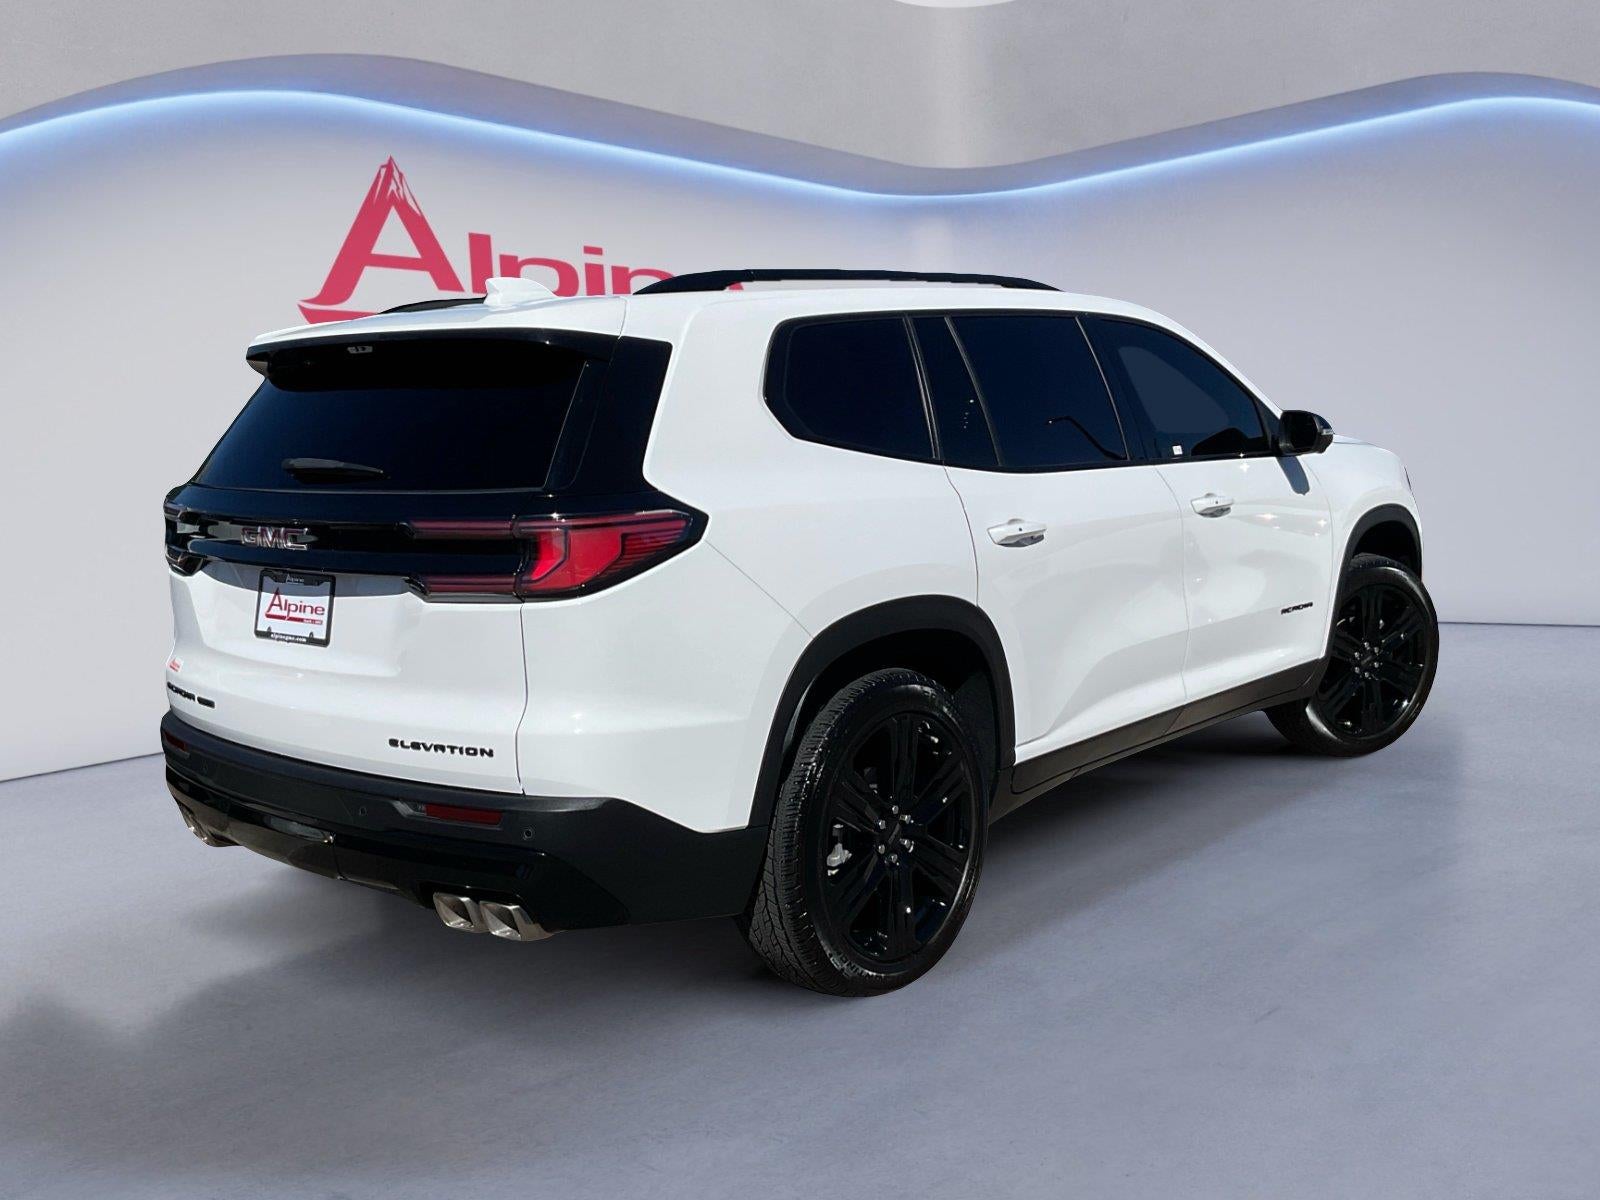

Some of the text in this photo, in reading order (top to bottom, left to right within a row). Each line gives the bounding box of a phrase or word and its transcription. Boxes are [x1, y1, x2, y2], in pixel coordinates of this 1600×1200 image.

[298, 155, 744, 305] Alpin
[240, 526, 308, 550] GMC
[266, 587, 325, 618] Alpine
[389, 738, 494, 758] ELEVATION
